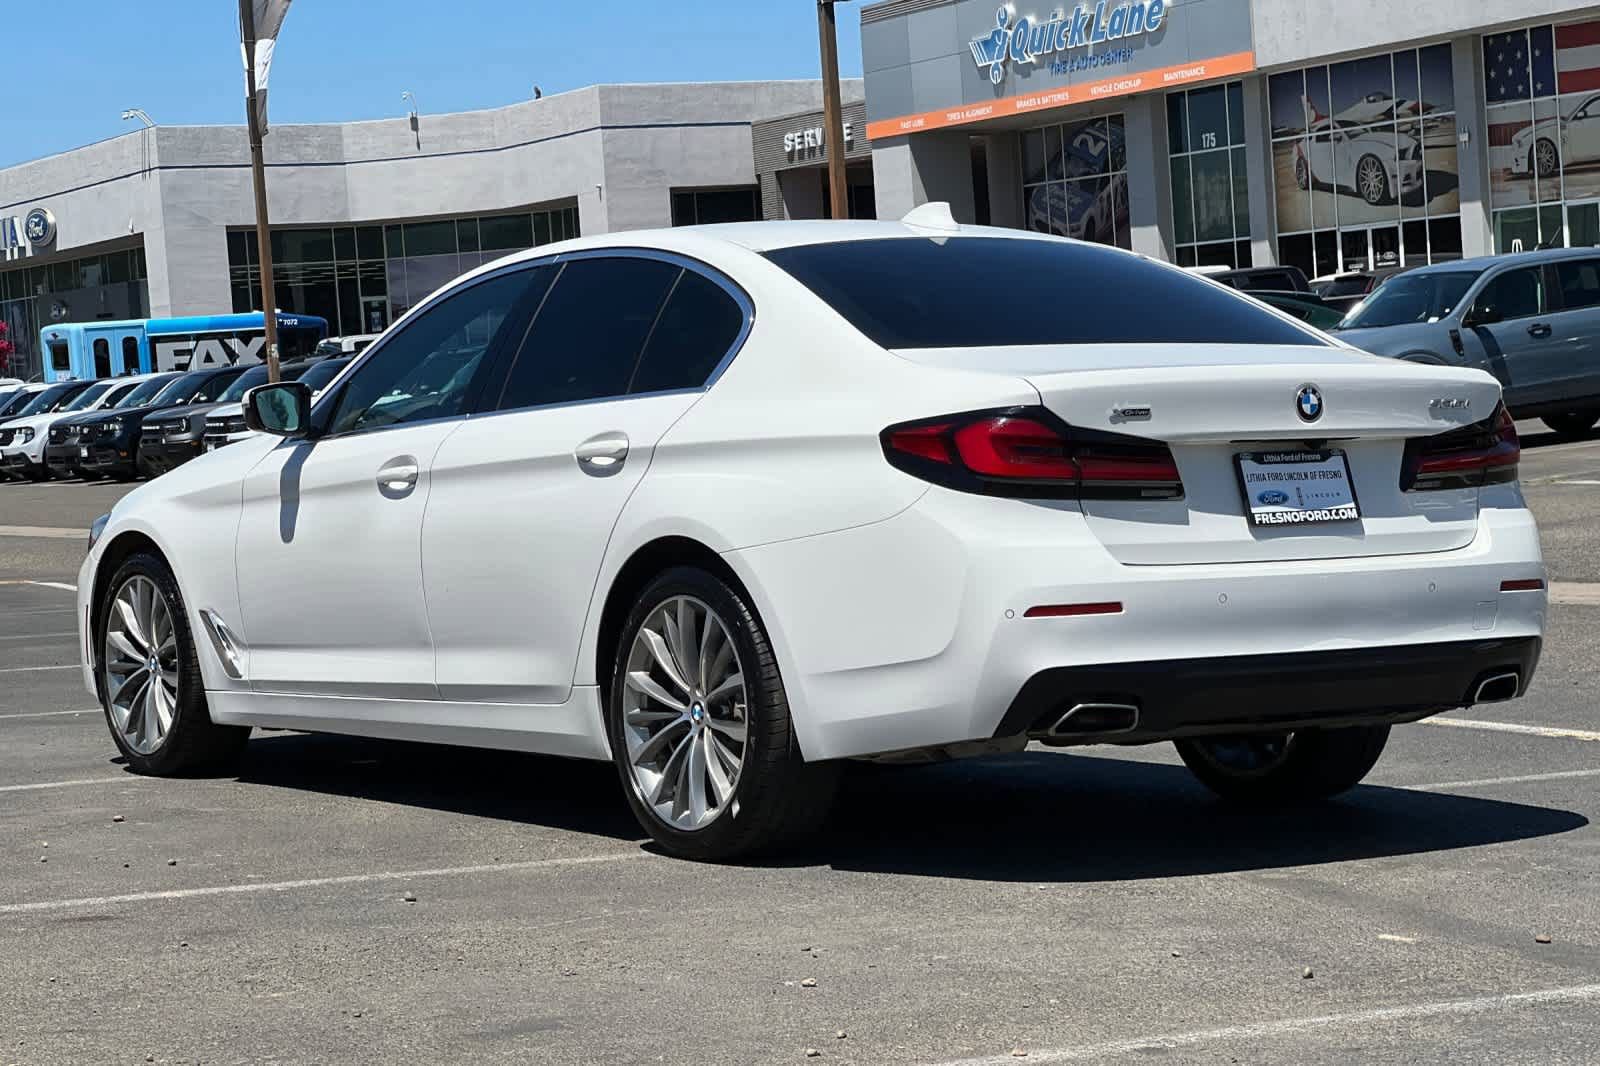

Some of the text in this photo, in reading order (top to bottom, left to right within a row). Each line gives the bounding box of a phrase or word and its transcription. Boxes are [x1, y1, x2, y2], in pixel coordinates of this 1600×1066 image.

[1010, 0, 1166, 64] Quick Lane
[1049, 61, 1068, 76] TIRE
[1075, 54, 1099, 71] AUTO
[1100, 47, 1136, 66] CENTER
[1163, 65, 1206, 81] MAINTENANCE
[784, 122, 853, 152] SERVE
[1202, 132, 1216, 149] 175
[155, 336, 267, 373] FAX
[1263, 454, 1280, 463] Lithia
[1280, 454, 1294, 462] Ford
[1302, 453, 1321, 461] Fresno
[1247, 470, 1342, 483] LITHIA FORD LINCOLN OF FRESNO
[1254, 508, 1359, 525] FRESNOFORD.COM
